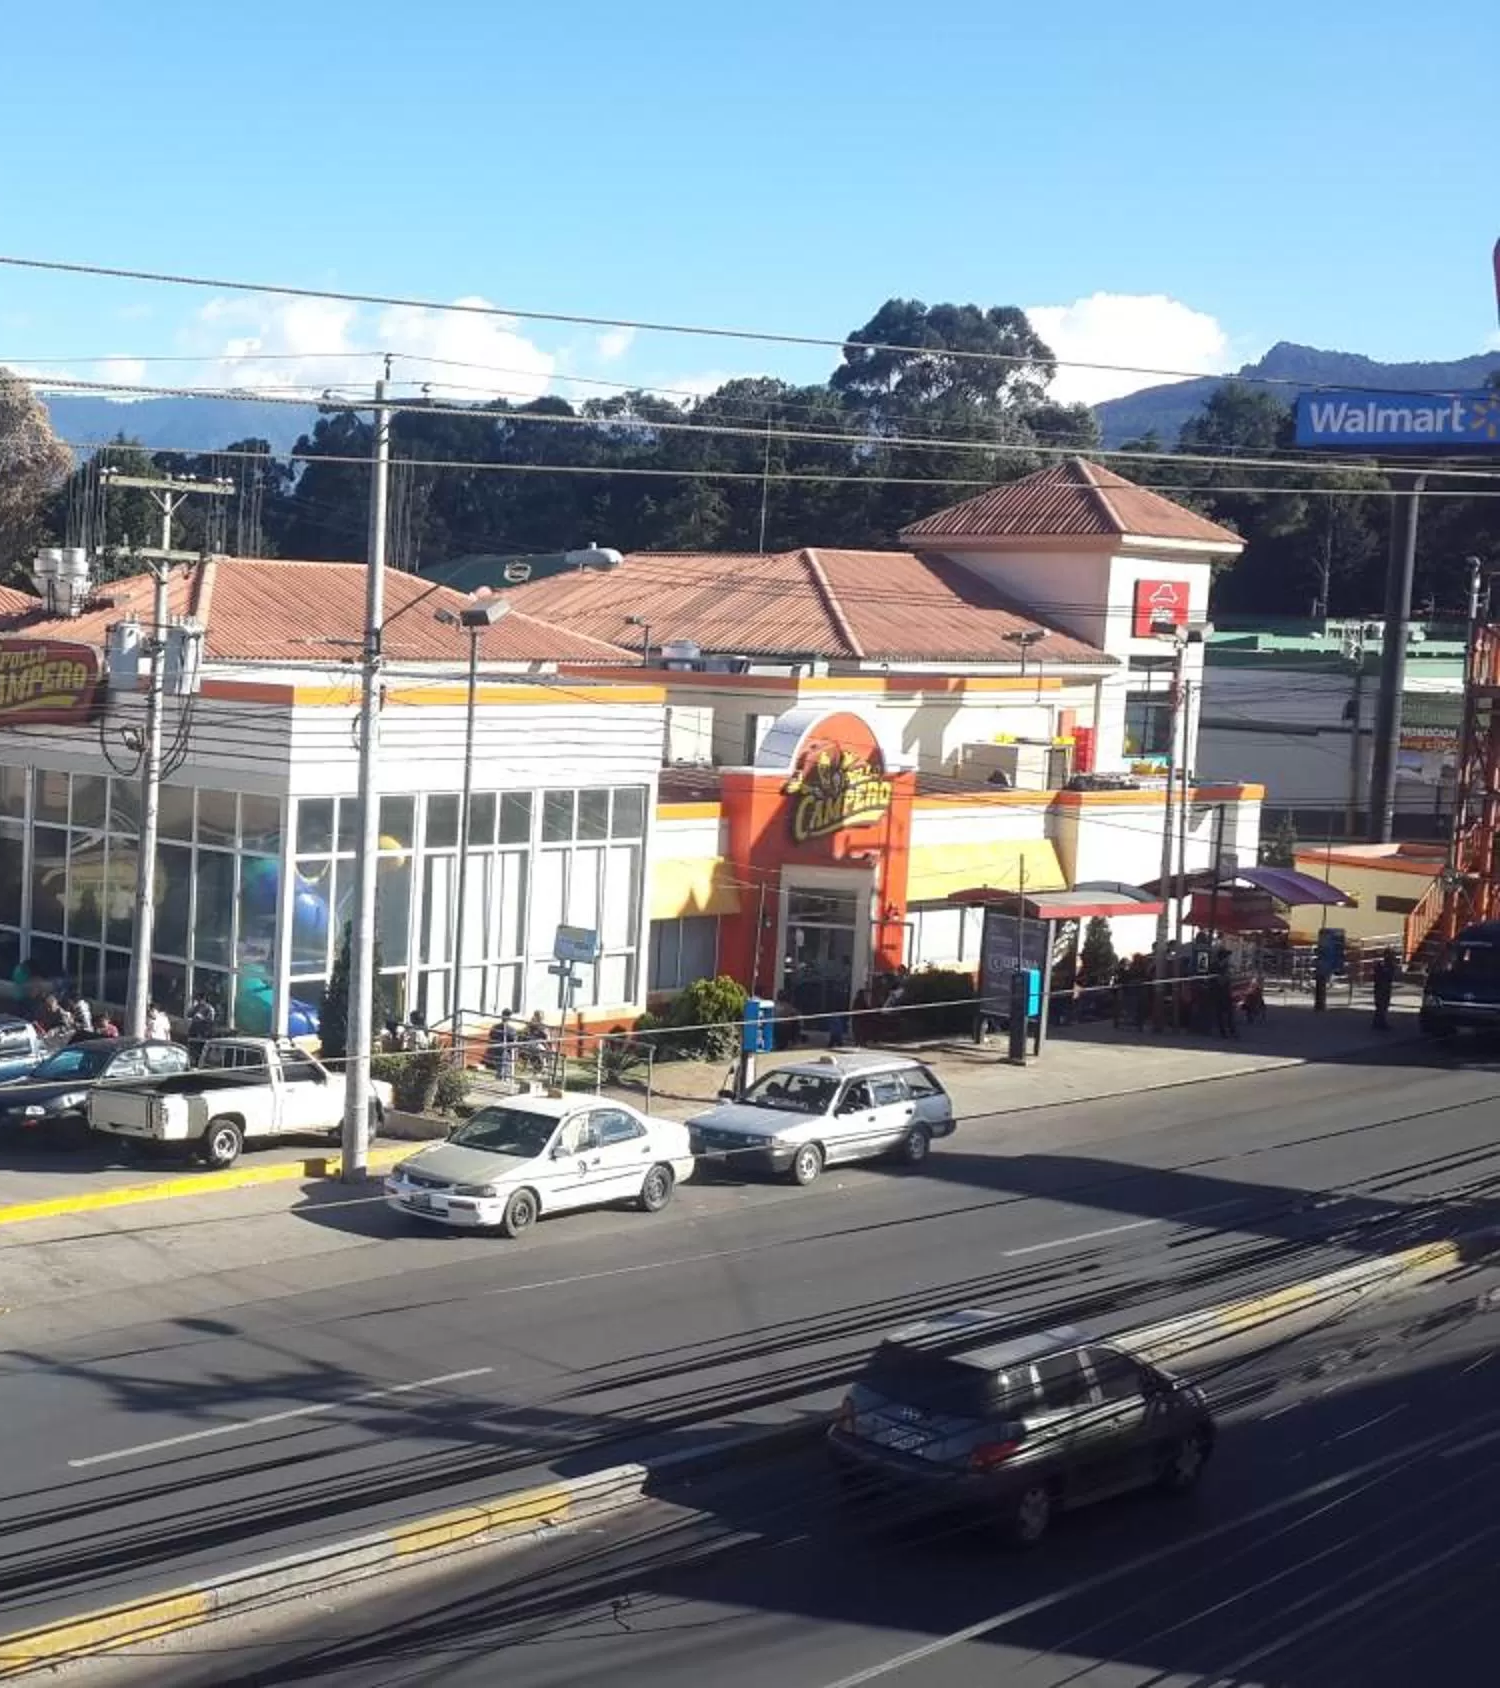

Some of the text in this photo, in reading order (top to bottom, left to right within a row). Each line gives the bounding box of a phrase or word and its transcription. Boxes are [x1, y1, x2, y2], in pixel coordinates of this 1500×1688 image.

[1310, 400, 1466, 433] Walmart
[0, 647, 47, 669] POLLO
[795, 781, 892, 840] CAMPERO
